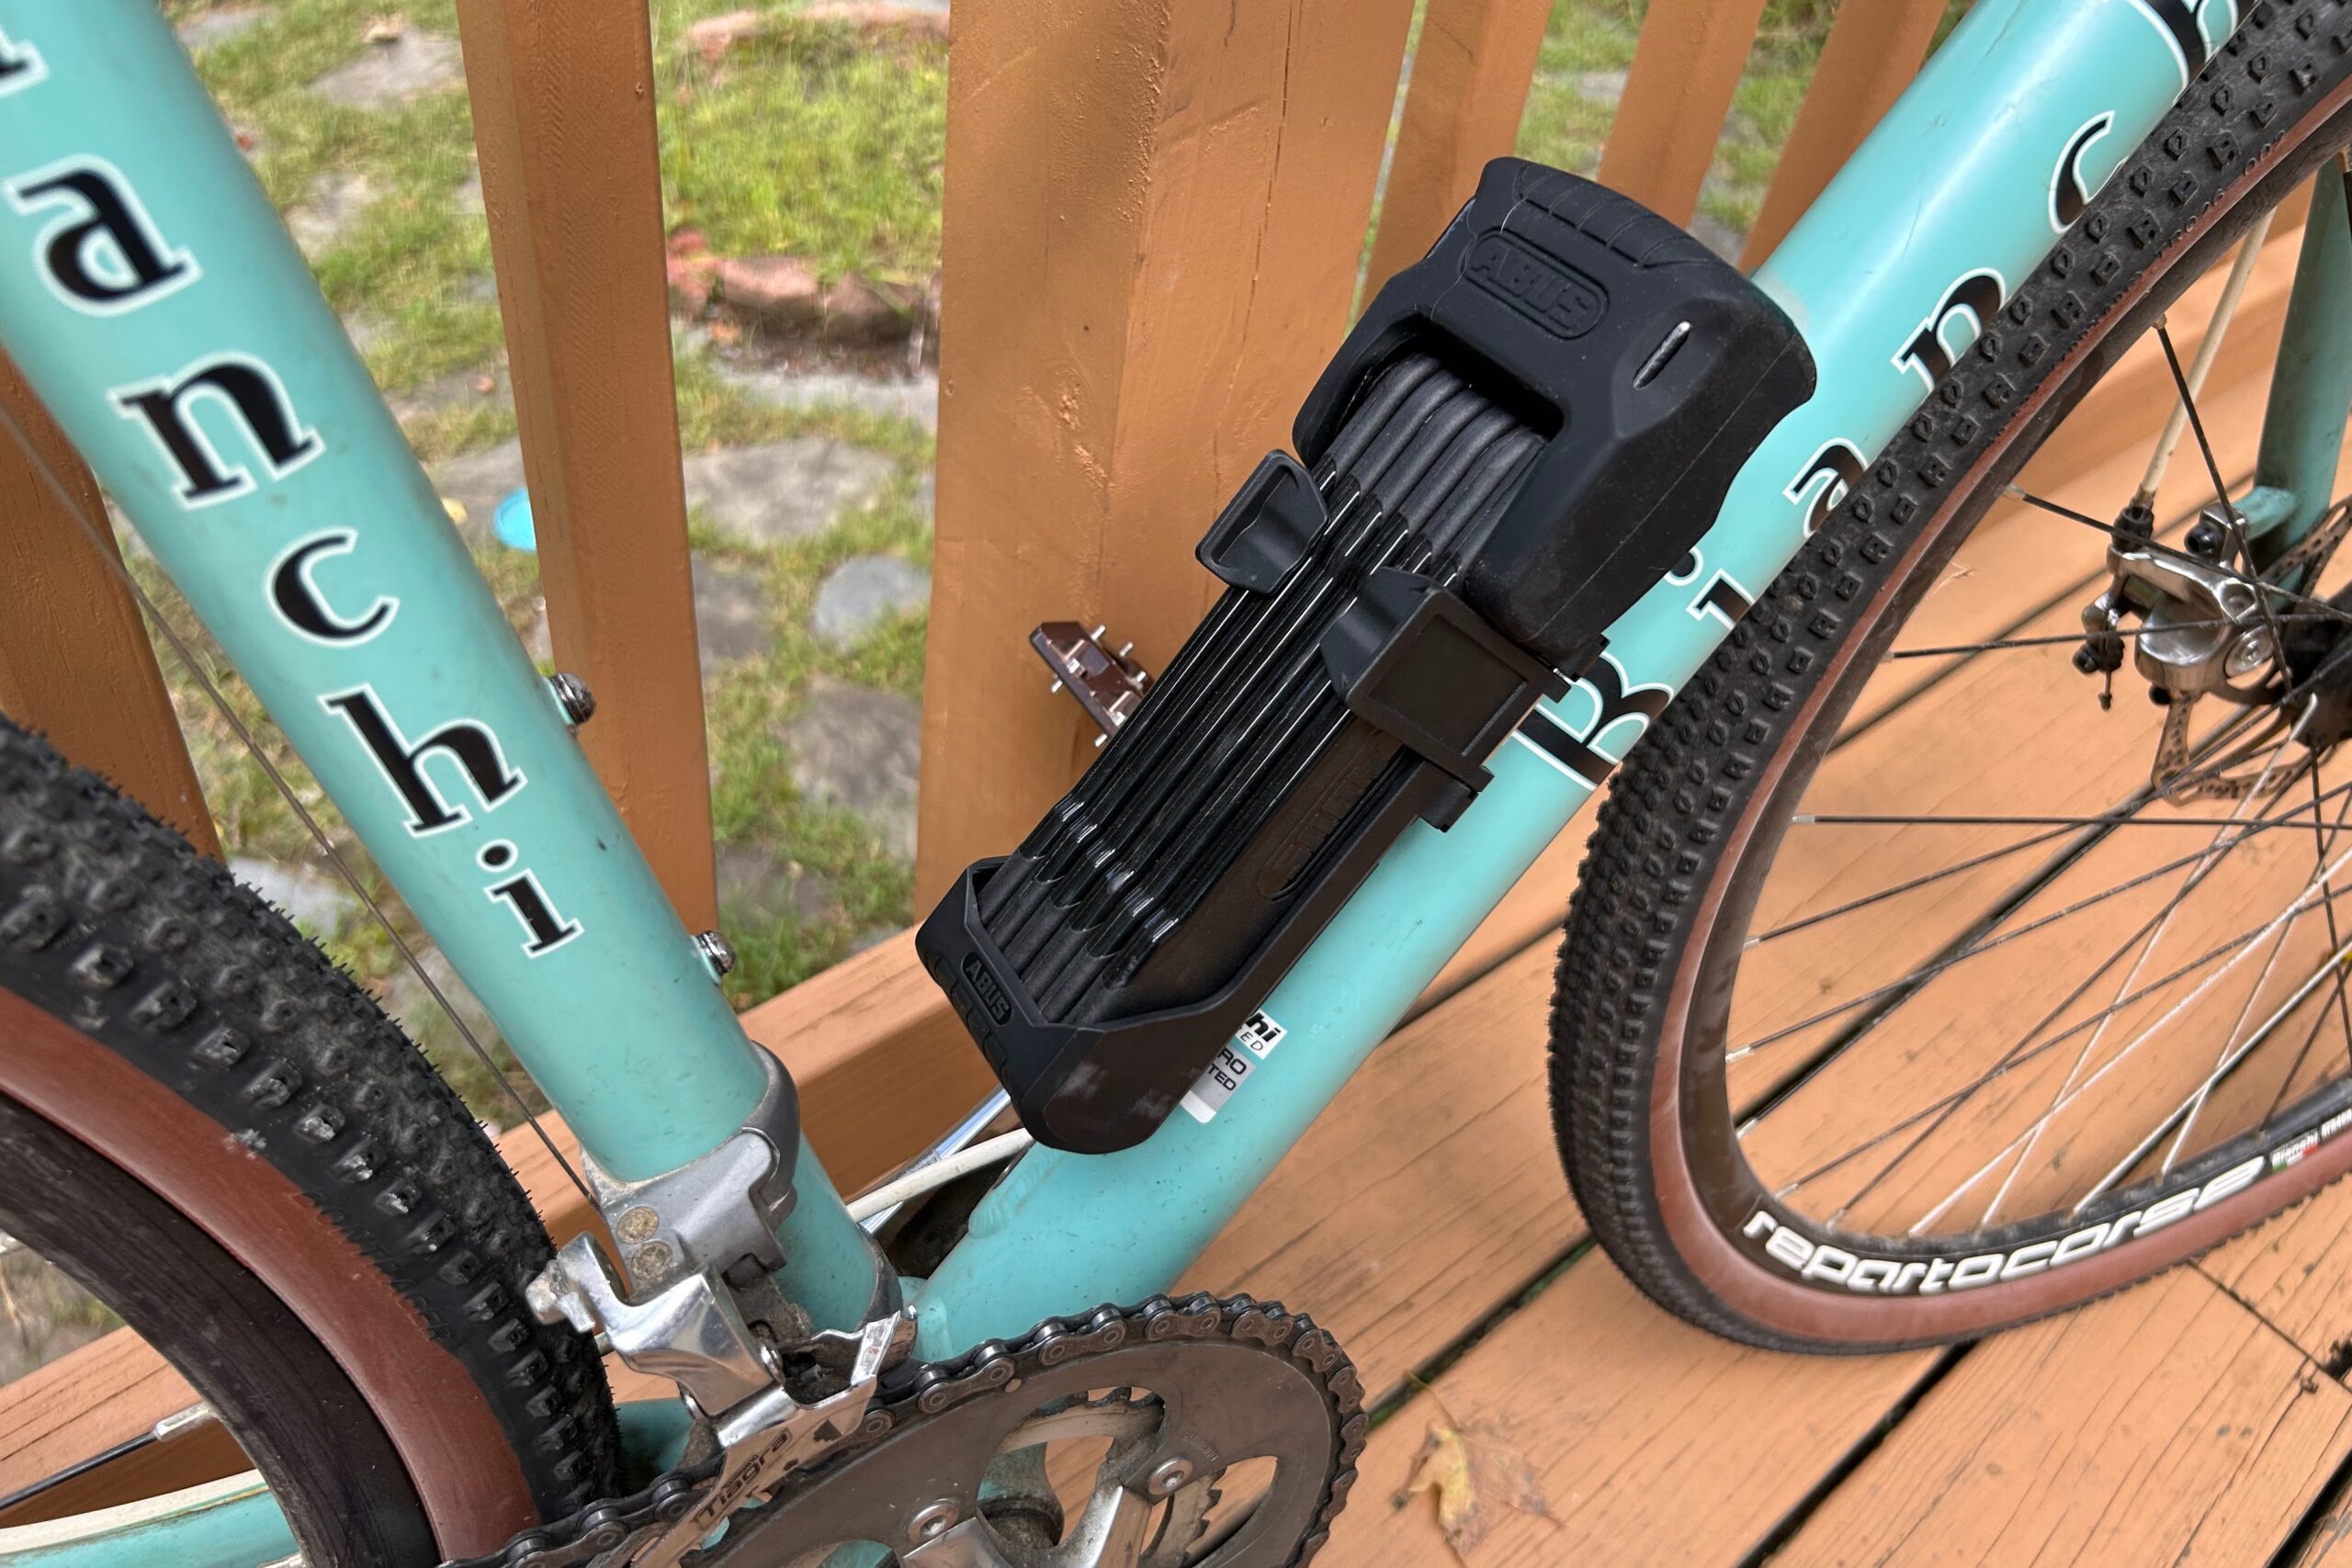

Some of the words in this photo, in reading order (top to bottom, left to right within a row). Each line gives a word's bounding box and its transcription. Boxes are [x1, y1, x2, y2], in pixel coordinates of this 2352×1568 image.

[1469, 242, 1592, 331] ABUS
[965, 959, 1011, 1021] ABUS
[1743, 1154, 2266, 1295] repartocorse
[700, 1430, 790, 1517] Tiagra
